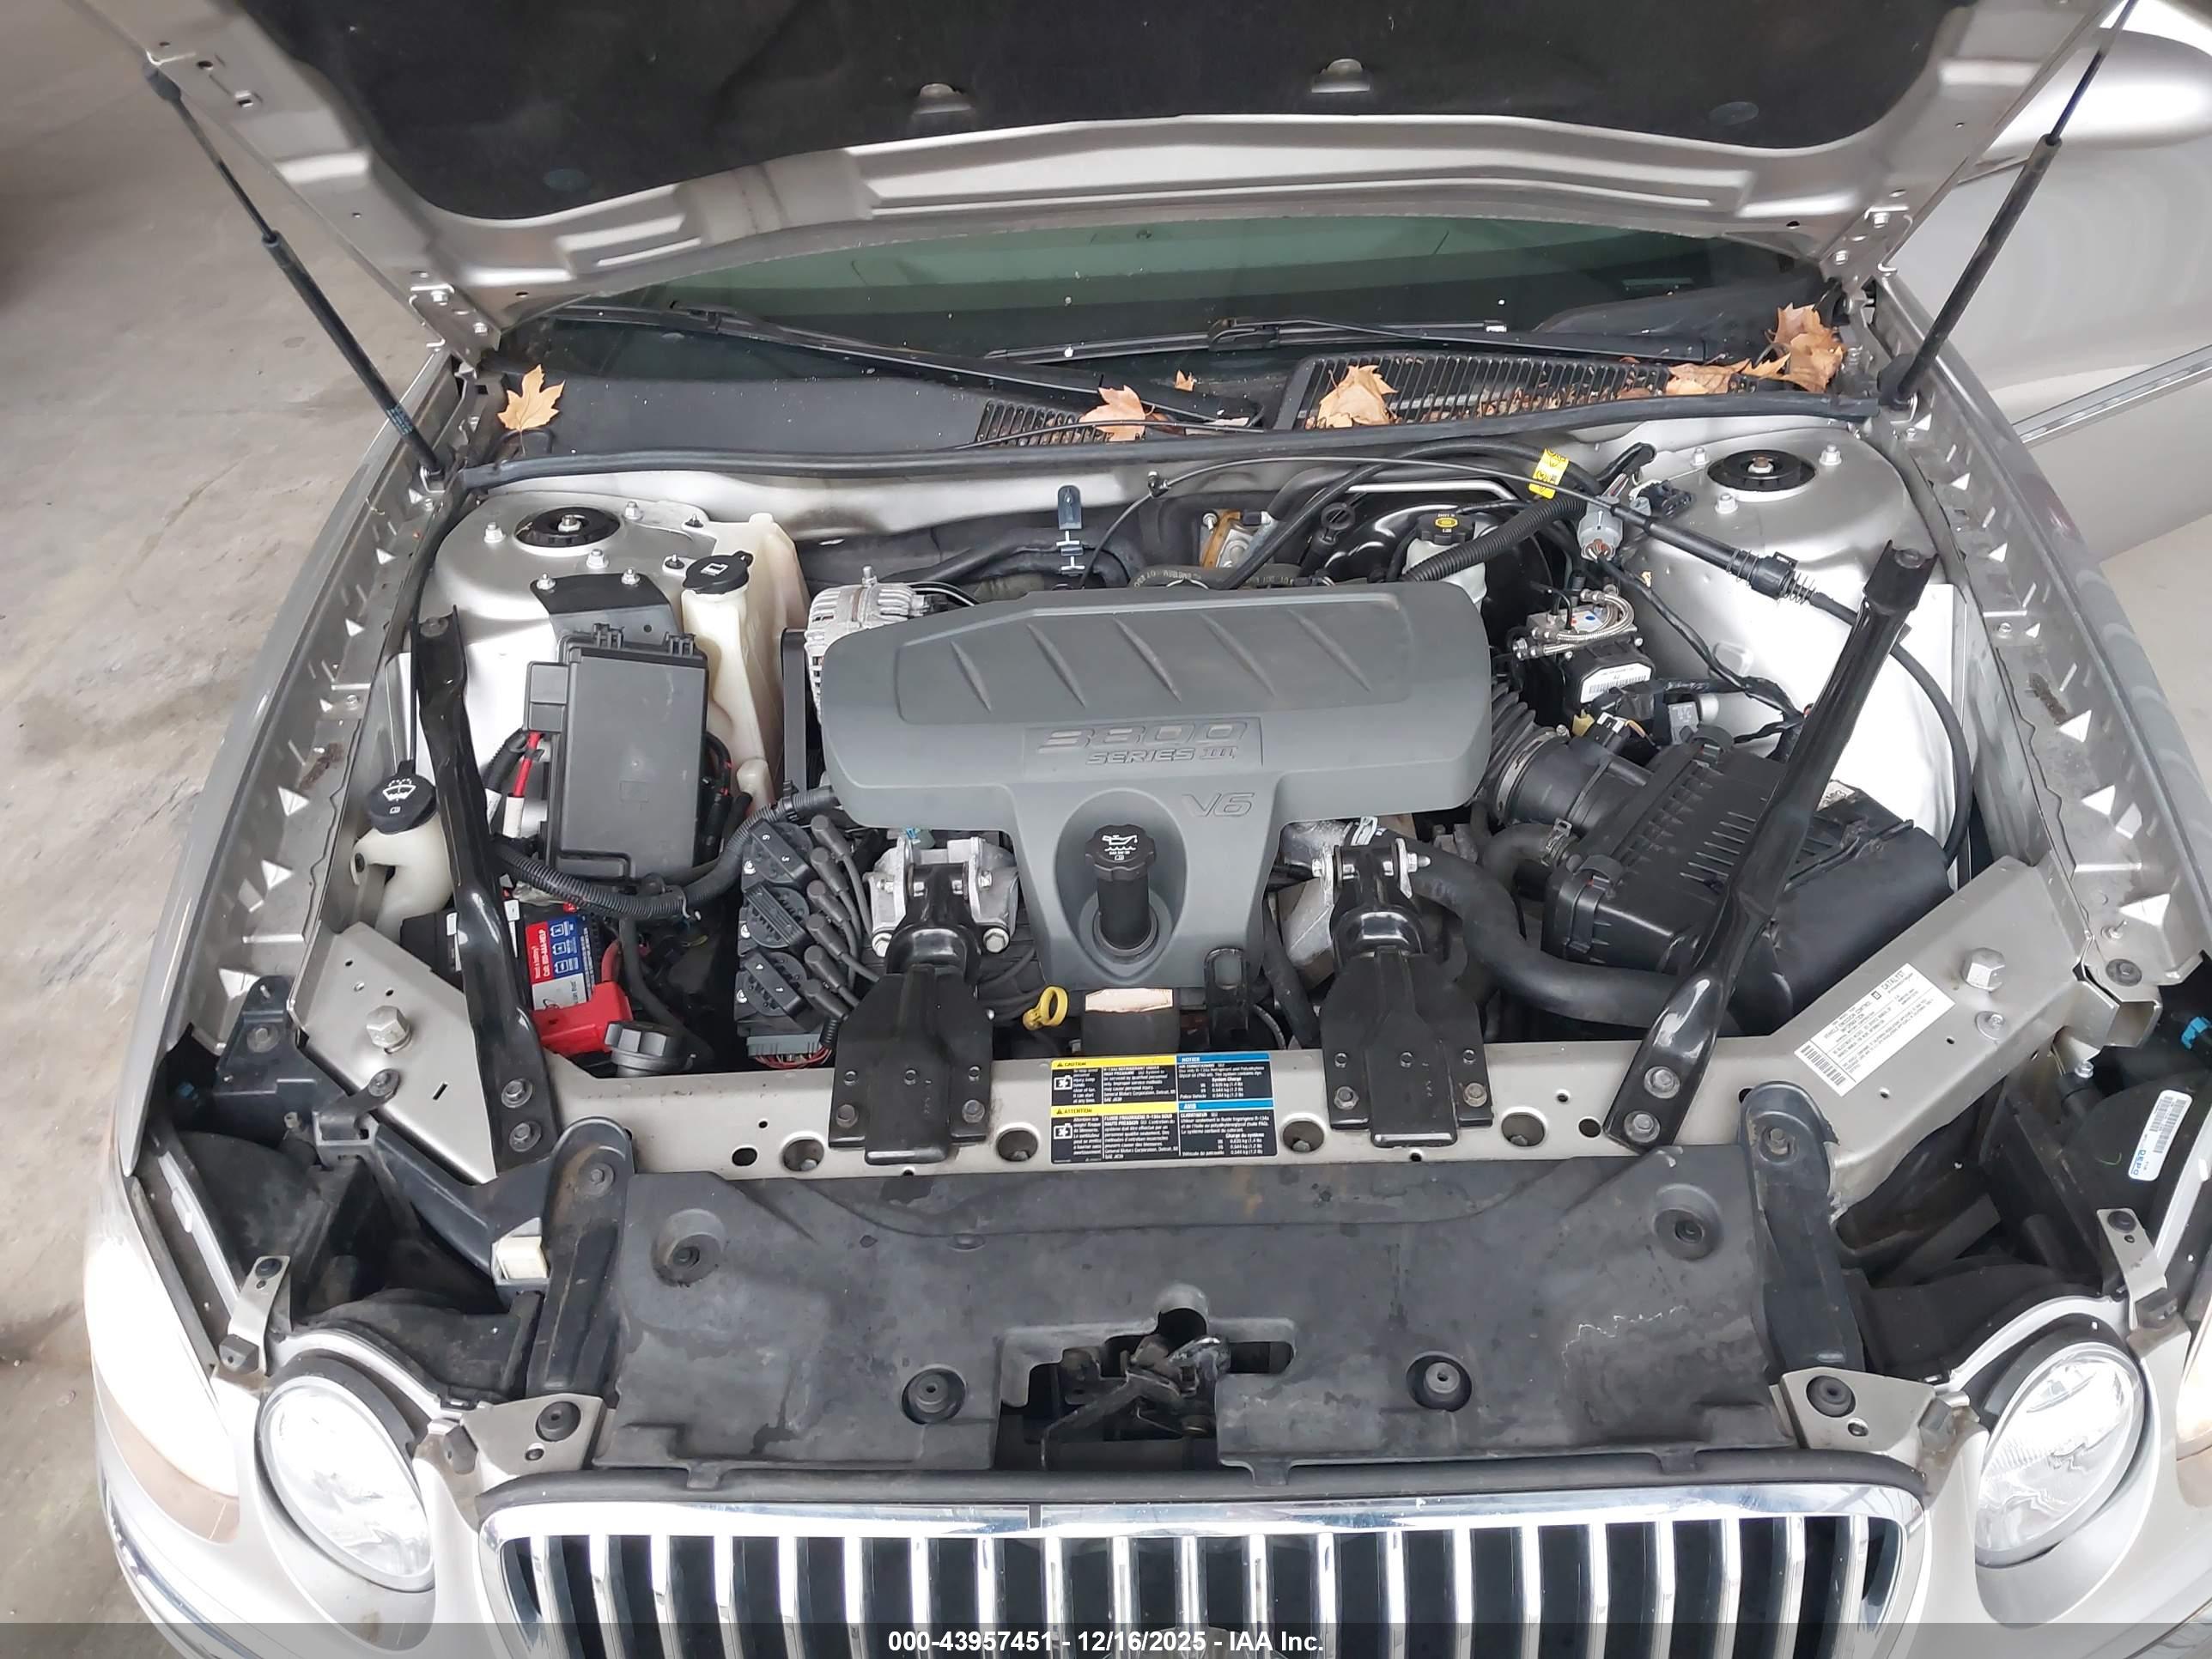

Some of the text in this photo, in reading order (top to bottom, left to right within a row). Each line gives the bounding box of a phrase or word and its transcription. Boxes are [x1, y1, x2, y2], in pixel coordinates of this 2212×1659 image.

[1037, 721, 1248, 753] 3800
[1086, 747, 1195, 765] SERIES
[1182, 792, 1255, 817] V6
[1881, 970, 1904, 990] CATALYST
[2133, 1149, 2146, 1176] DEPO
